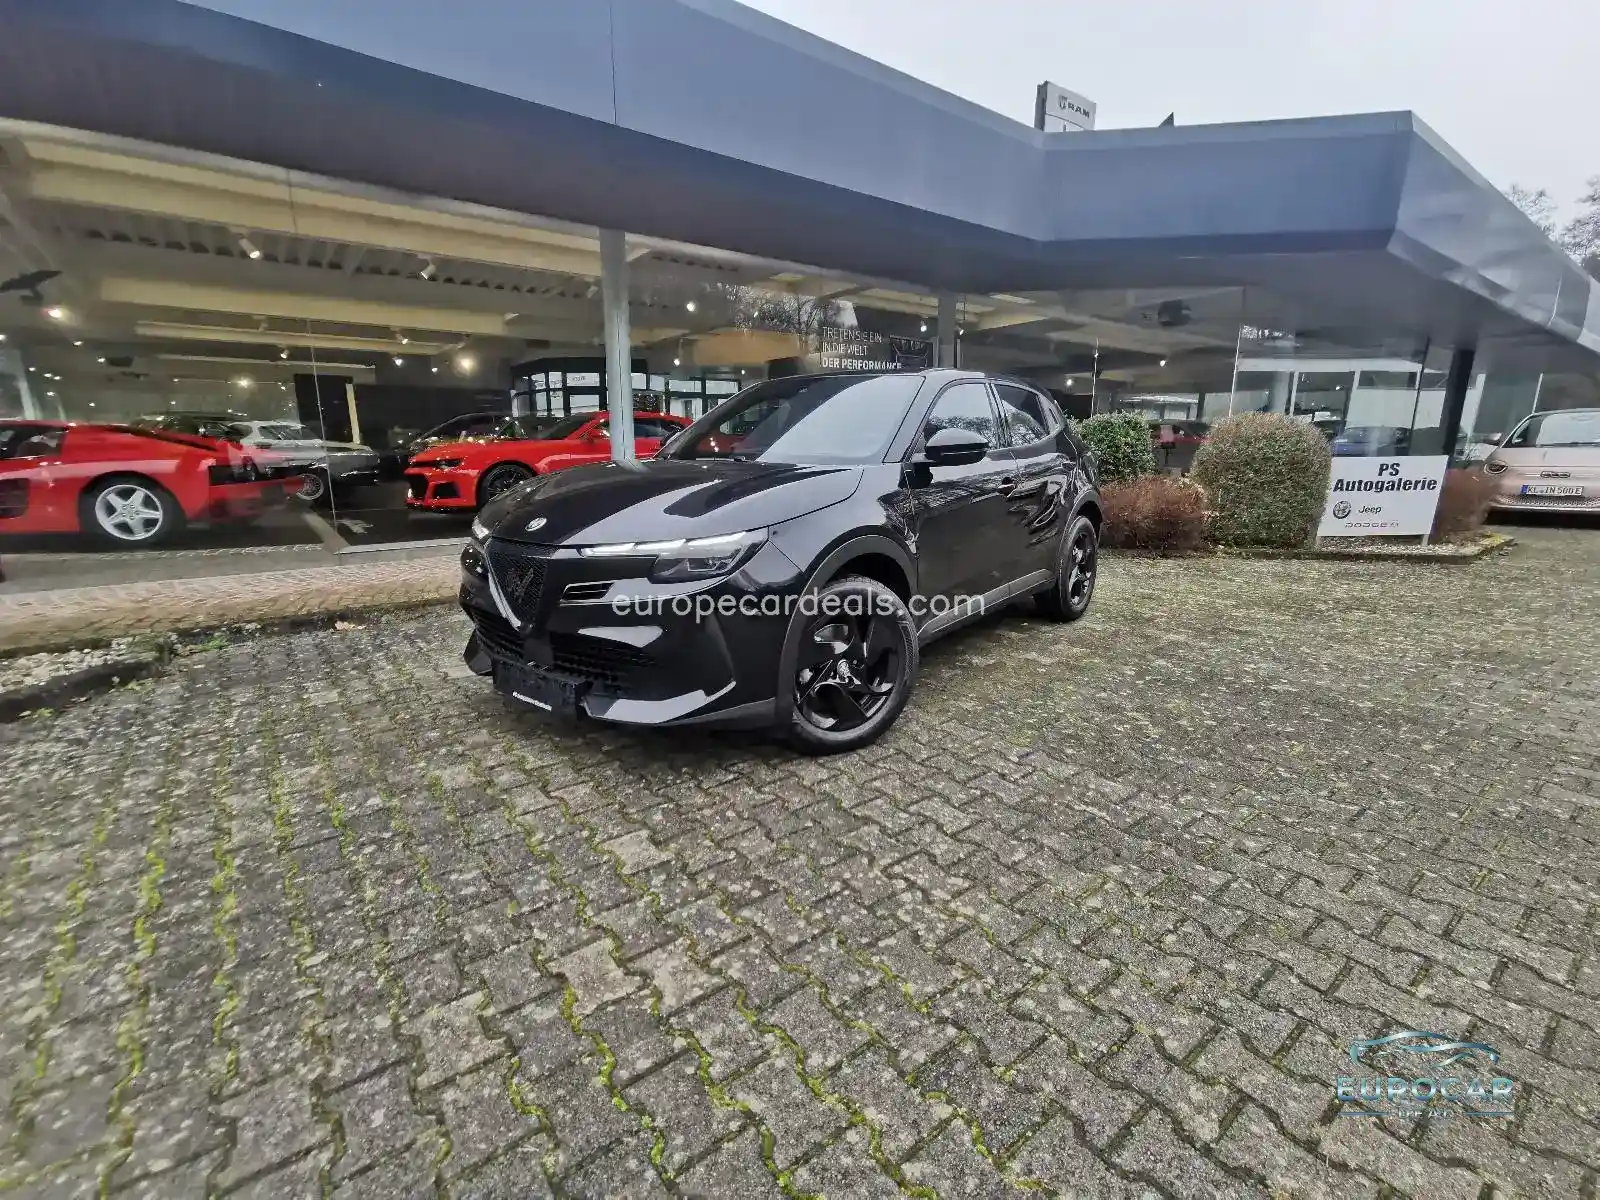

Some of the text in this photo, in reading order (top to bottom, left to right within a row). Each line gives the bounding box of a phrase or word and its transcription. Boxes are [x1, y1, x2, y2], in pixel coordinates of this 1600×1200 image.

[1068, 102, 1089, 118] RAM
[822, 326, 855, 340] TRETEN
[822, 342, 868, 356] IN DIE WELT
[822, 357, 840, 368] DER
[1378, 463, 1400, 476] PS
[1333, 477, 1438, 493] Autogalerie
[1358, 505, 1382, 515] Jeep
